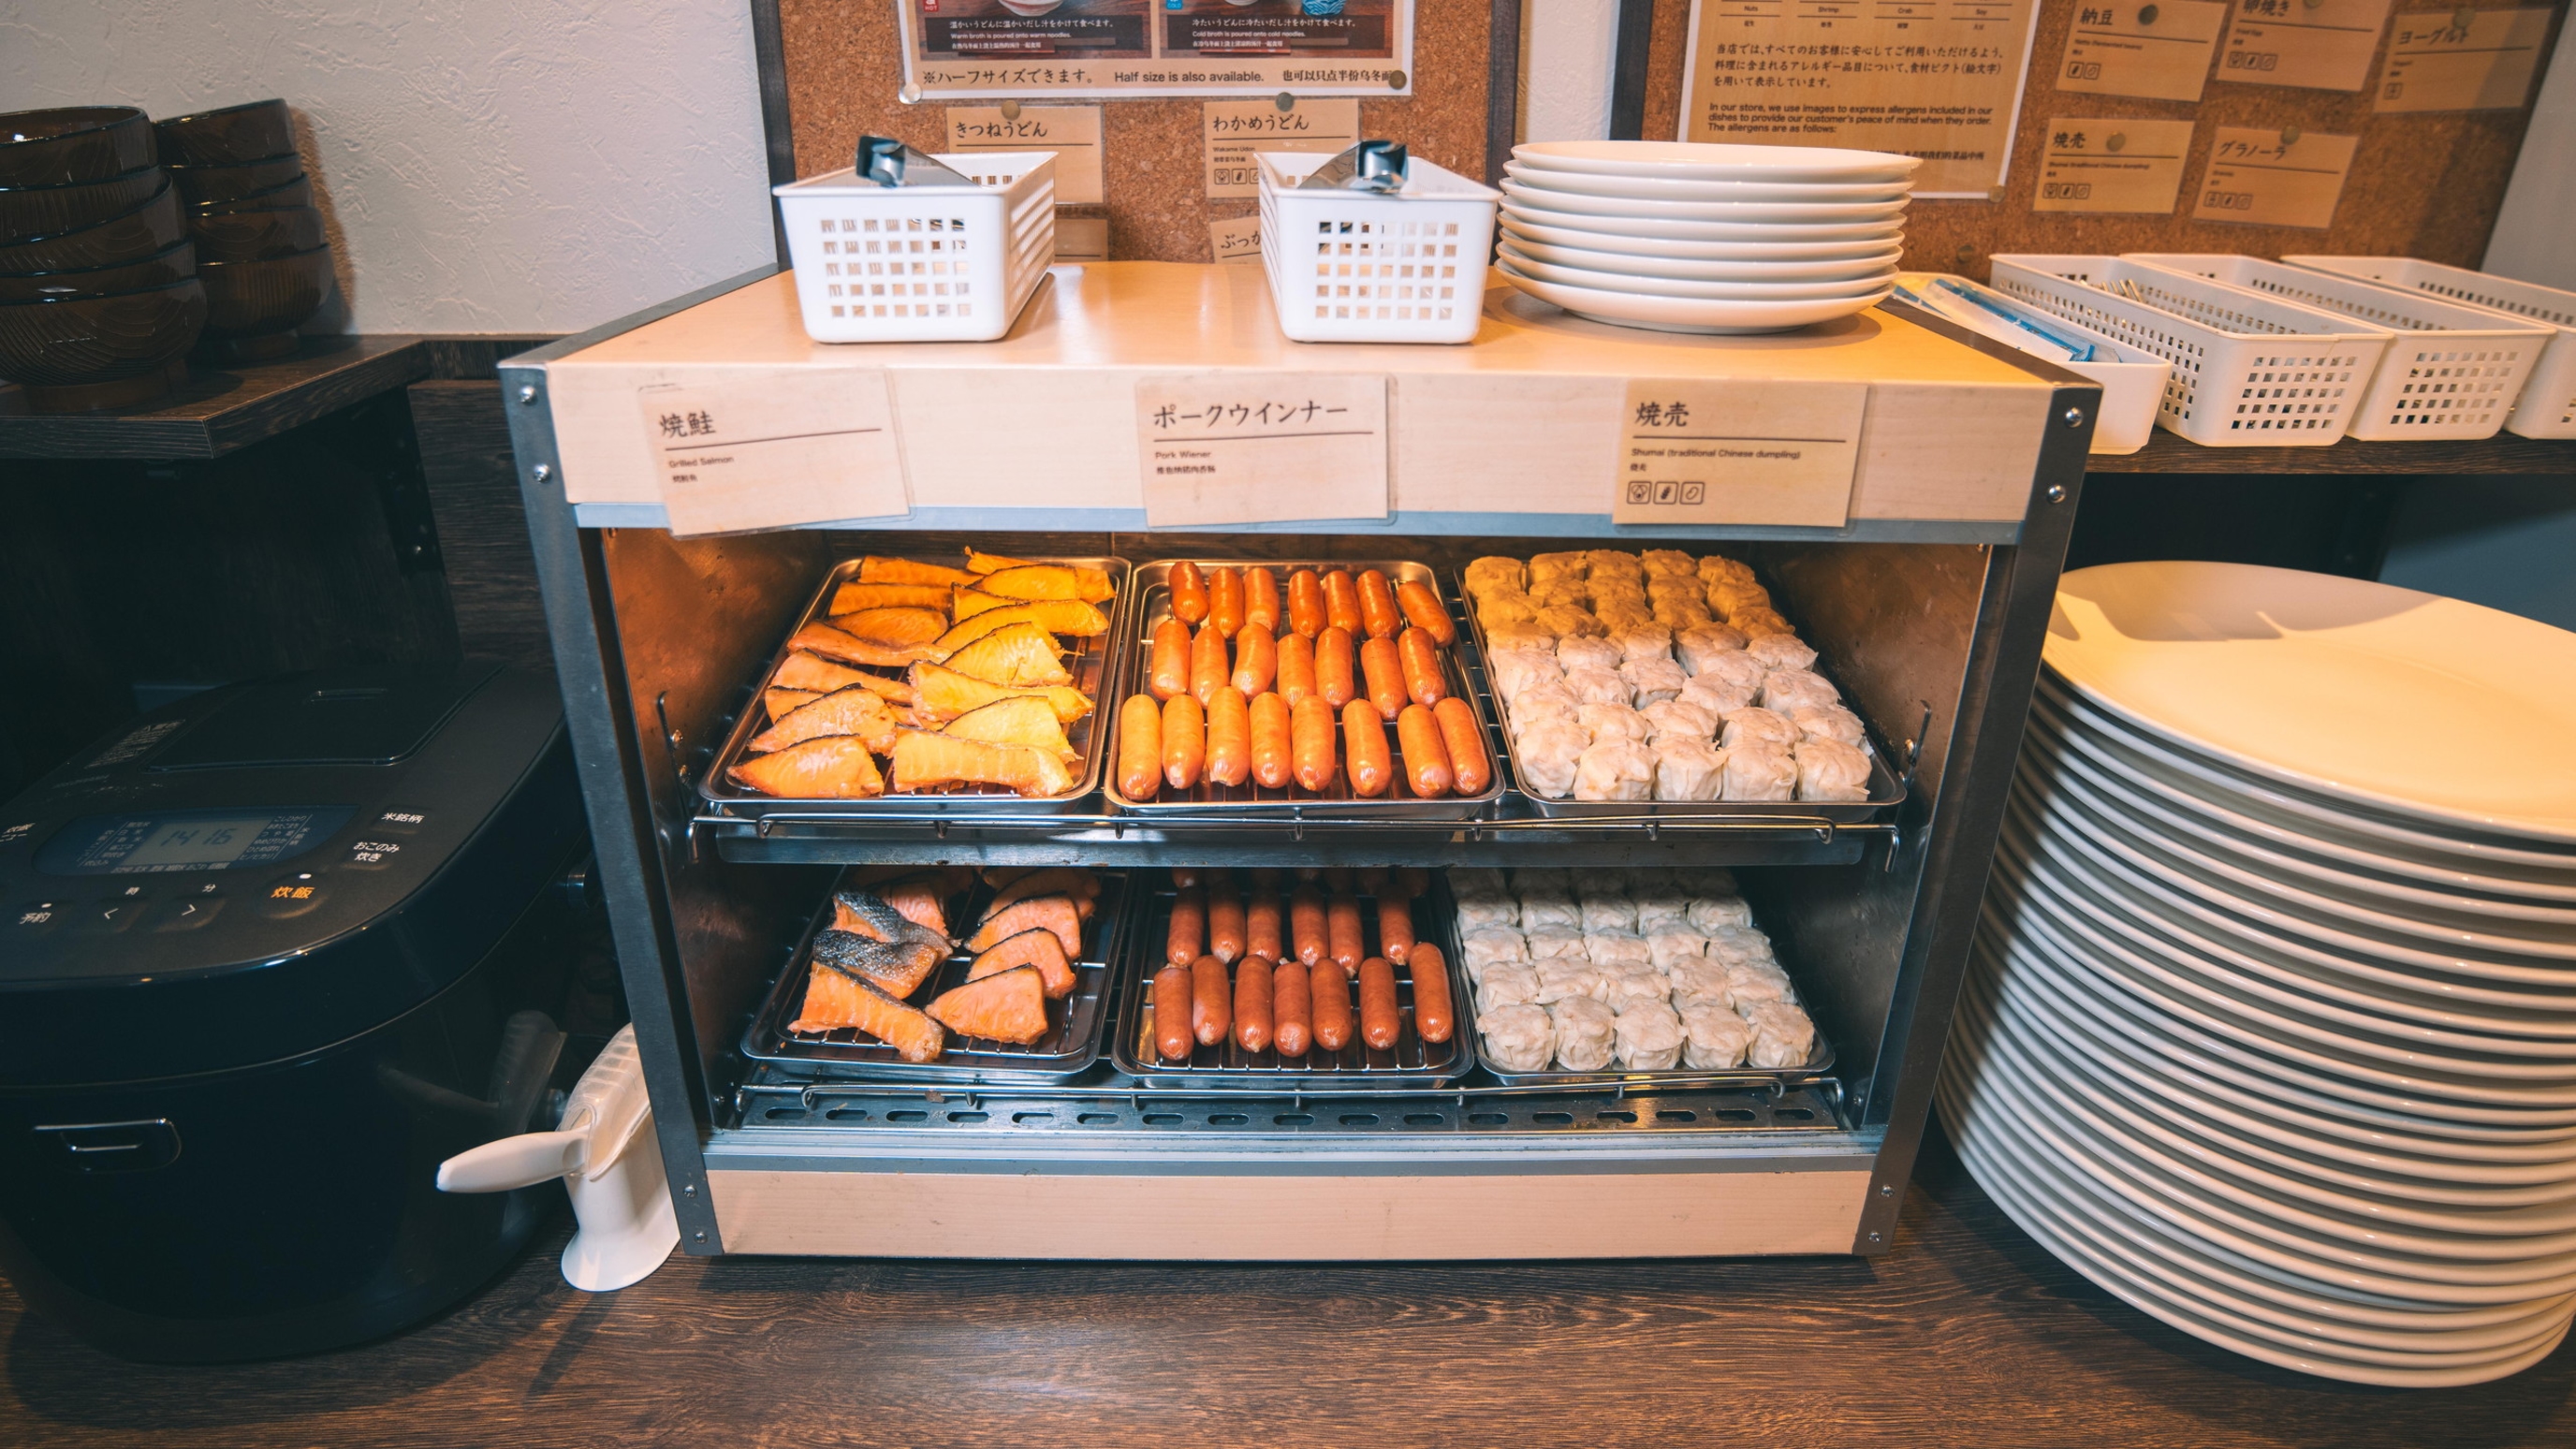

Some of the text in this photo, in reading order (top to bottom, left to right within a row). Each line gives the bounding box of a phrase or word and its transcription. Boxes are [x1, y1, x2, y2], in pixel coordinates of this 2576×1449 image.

[2080, 7, 2114, 25] 納豆
[2397, 26, 2469, 45] ヨーグルト
[923, 68, 1093, 84] ※ハーフサイズできます。
[1115, 71, 1265, 82] Half size is also available.
[1714, 76, 1831, 89] を用いて表示しています。
[1709, 103, 1718, 111] In
[1739, 104, 1766, 112] store,
[1803, 105, 1835, 114] images
[1837, 105, 1847, 113] to
[1850, 107, 1885, 115] express
[1887, 105, 1927, 115] allergens
[1929, 106, 1966, 114] included
[1968, 106, 1976, 114] in
[1213, 114, 1310, 132] わかめうどん
[1708, 113, 1738, 122] dishes
[1740, 113, 1749, 122] to
[1751, 113, 1786, 124] provide
[1856, 116, 1882, 124] peace
[1884, 115, 1894, 124] of
[1895, 115, 1918, 124] mind
[1920, 116, 1943, 124] when
[1945, 116, 1966, 125] they
[1967, 116, 1992, 124] order.
[956, 121, 1048, 138] きつねうどん
[1708, 123, 1725, 132] The
[1727, 124, 1770, 134] allergens
[1803, 124, 1837, 134] follows:
[2053, 131, 2086, 149] 焼売
[2218, 140, 2287, 161] グラノーラ
[1153, 400, 1348, 430] ポークウインナー
[1634, 401, 1690, 428] 焼売
[659, 410, 716, 439] 焼鮭
[1154, 450, 1212, 461] Pork Wiener
[1631, 448, 1801, 461] Shumai (traditional Chinese dumpling)
[668, 455, 735, 469] Grilled Salmon
[382, 812, 425, 824] 米銘柄
[353, 842, 401, 853] おこのみ
[354, 852, 382, 862] 炊き
[202, 884, 216, 893] 分
[271, 886, 315, 899] 炊飯
[19, 912, 51, 925] 予約
